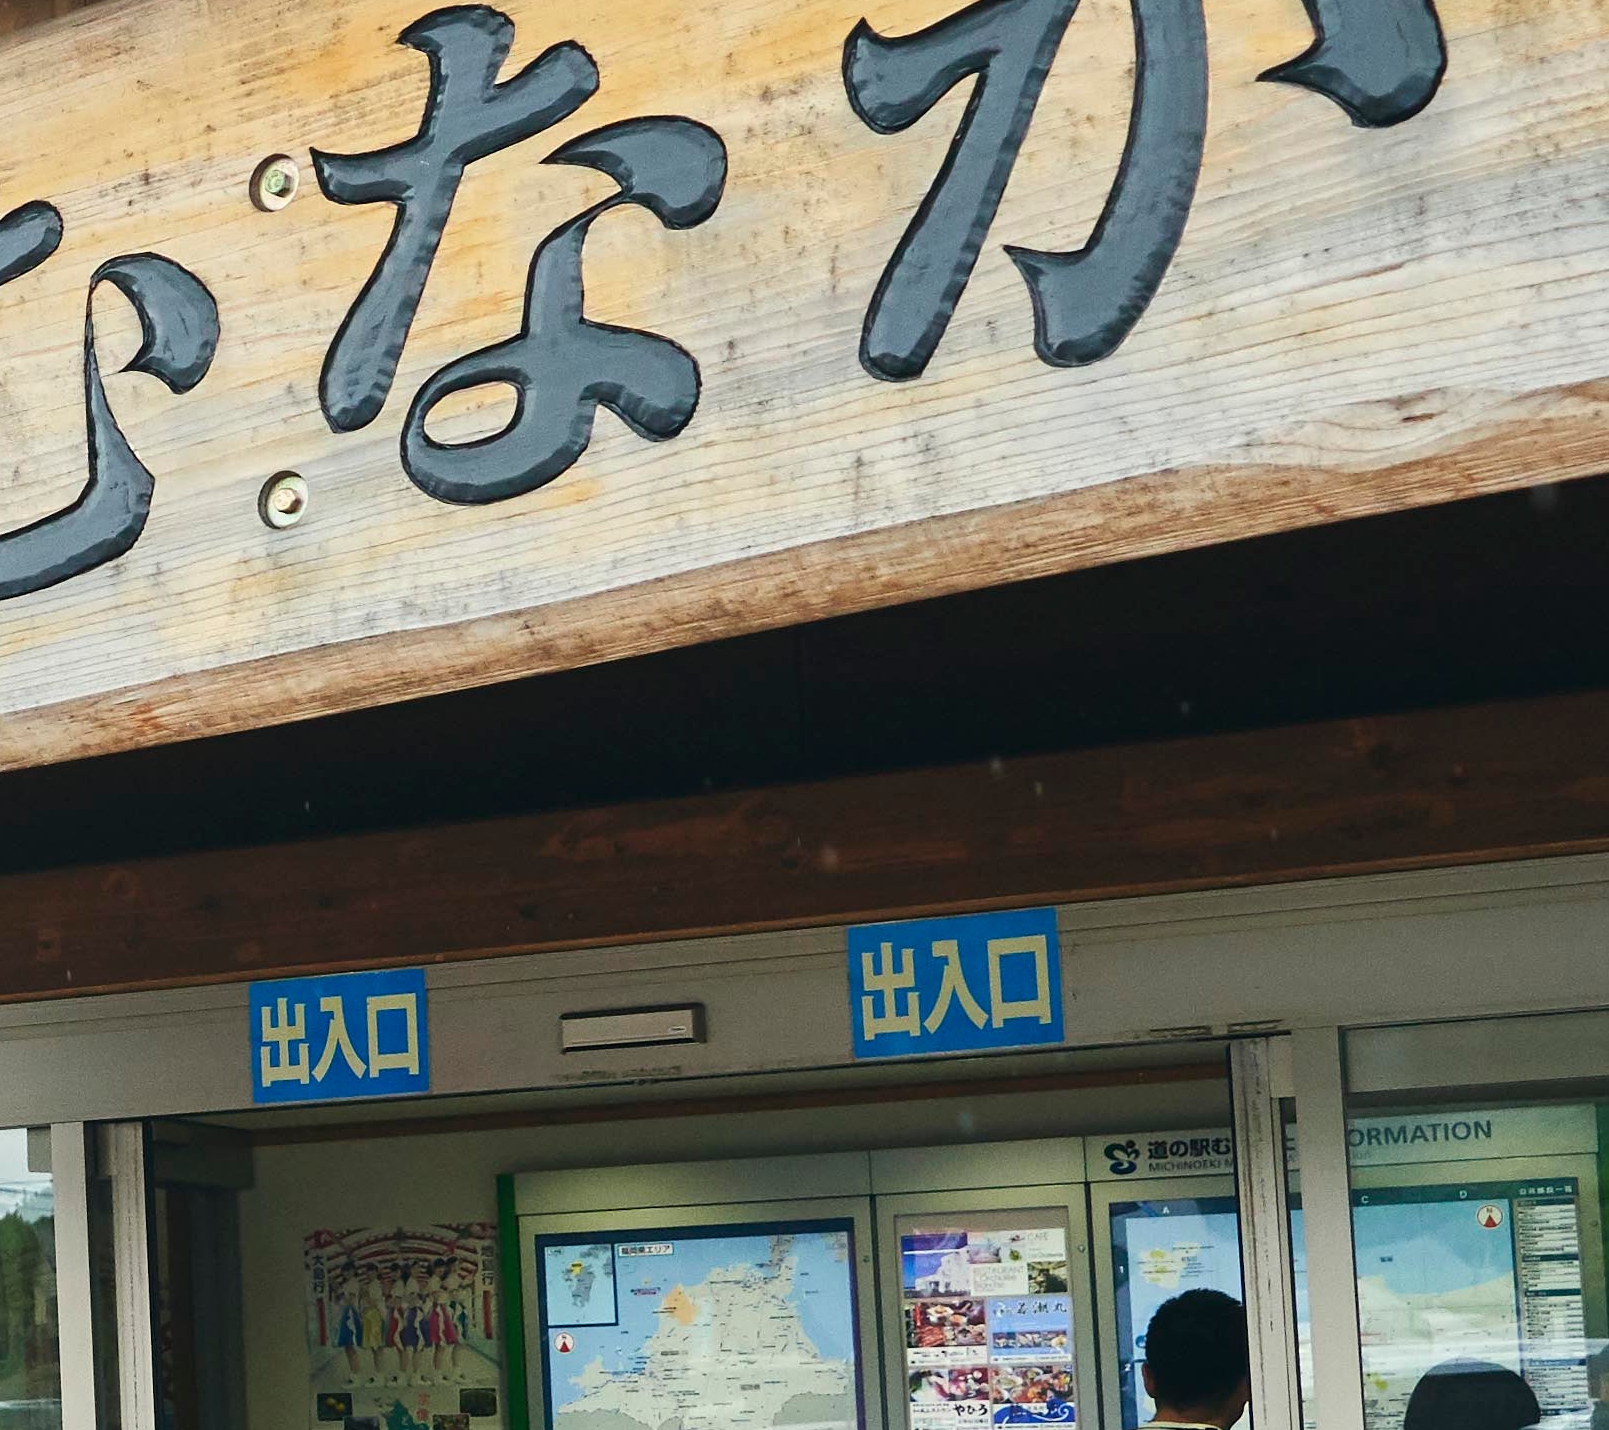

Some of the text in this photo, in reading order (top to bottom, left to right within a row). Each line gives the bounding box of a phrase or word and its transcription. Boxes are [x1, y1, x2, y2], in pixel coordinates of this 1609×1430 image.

[860, 932, 1054, 1041] 出入口
[258, 993, 421, 1090] 出入口
[1459, 1189, 1468, 1200] D
[1162, 1206, 1170, 1214] A
[954, 1403, 988, 1417] やひろ
